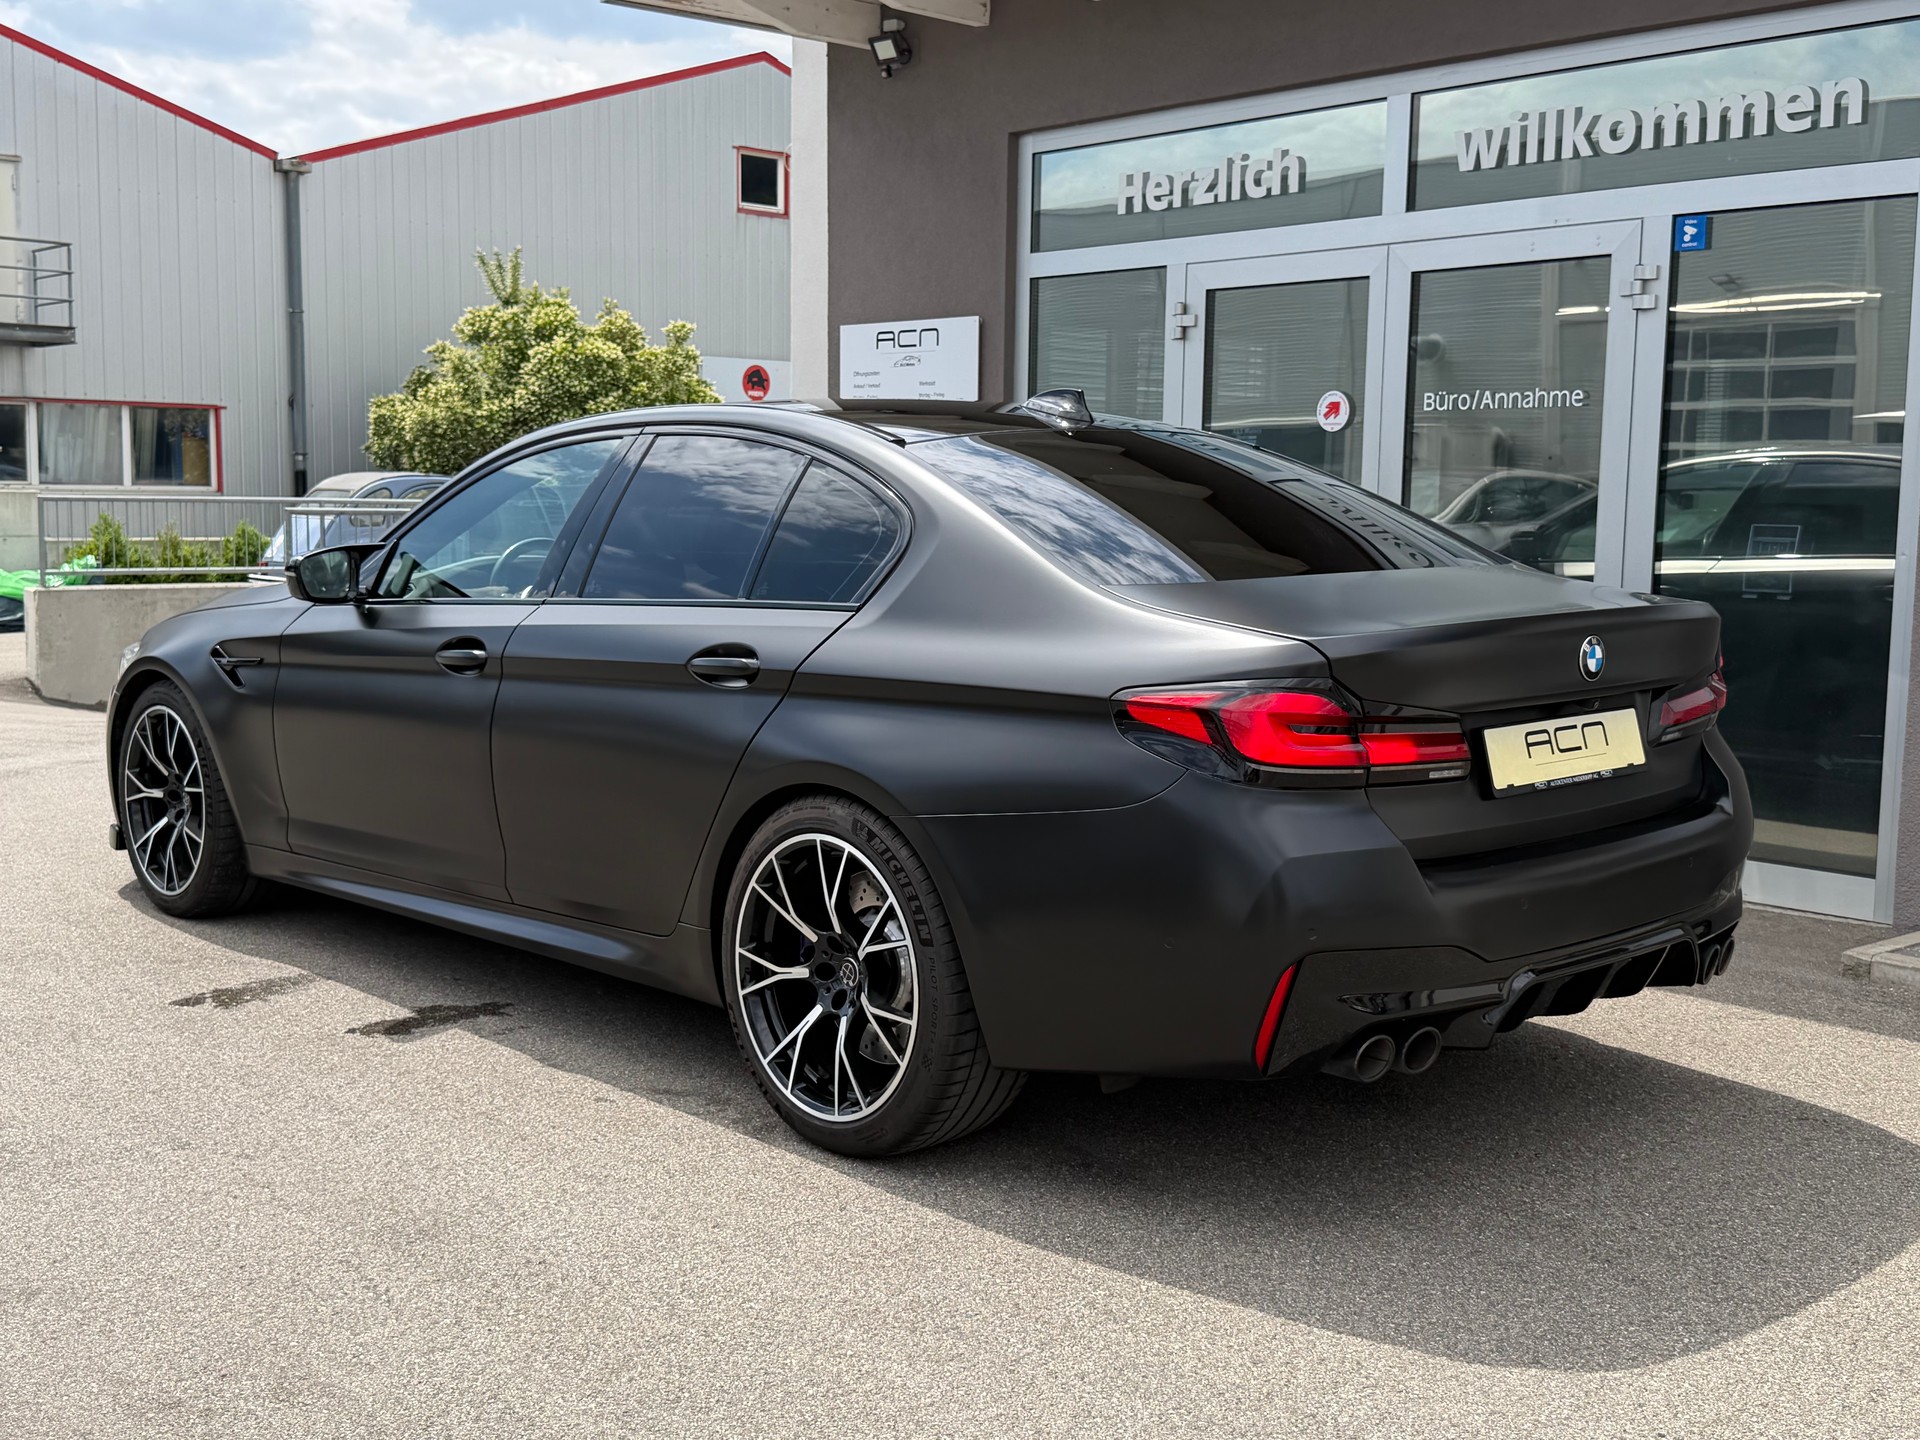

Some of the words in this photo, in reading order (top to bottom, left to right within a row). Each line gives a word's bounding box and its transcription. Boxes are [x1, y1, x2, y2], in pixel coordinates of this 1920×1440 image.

[1117, 147, 1302, 215] Herzlich
[1423, 387, 1584, 411] Büro/Annahme
[869, 836, 932, 941] MICHELIN
[928, 957, 938, 992] PILOT
